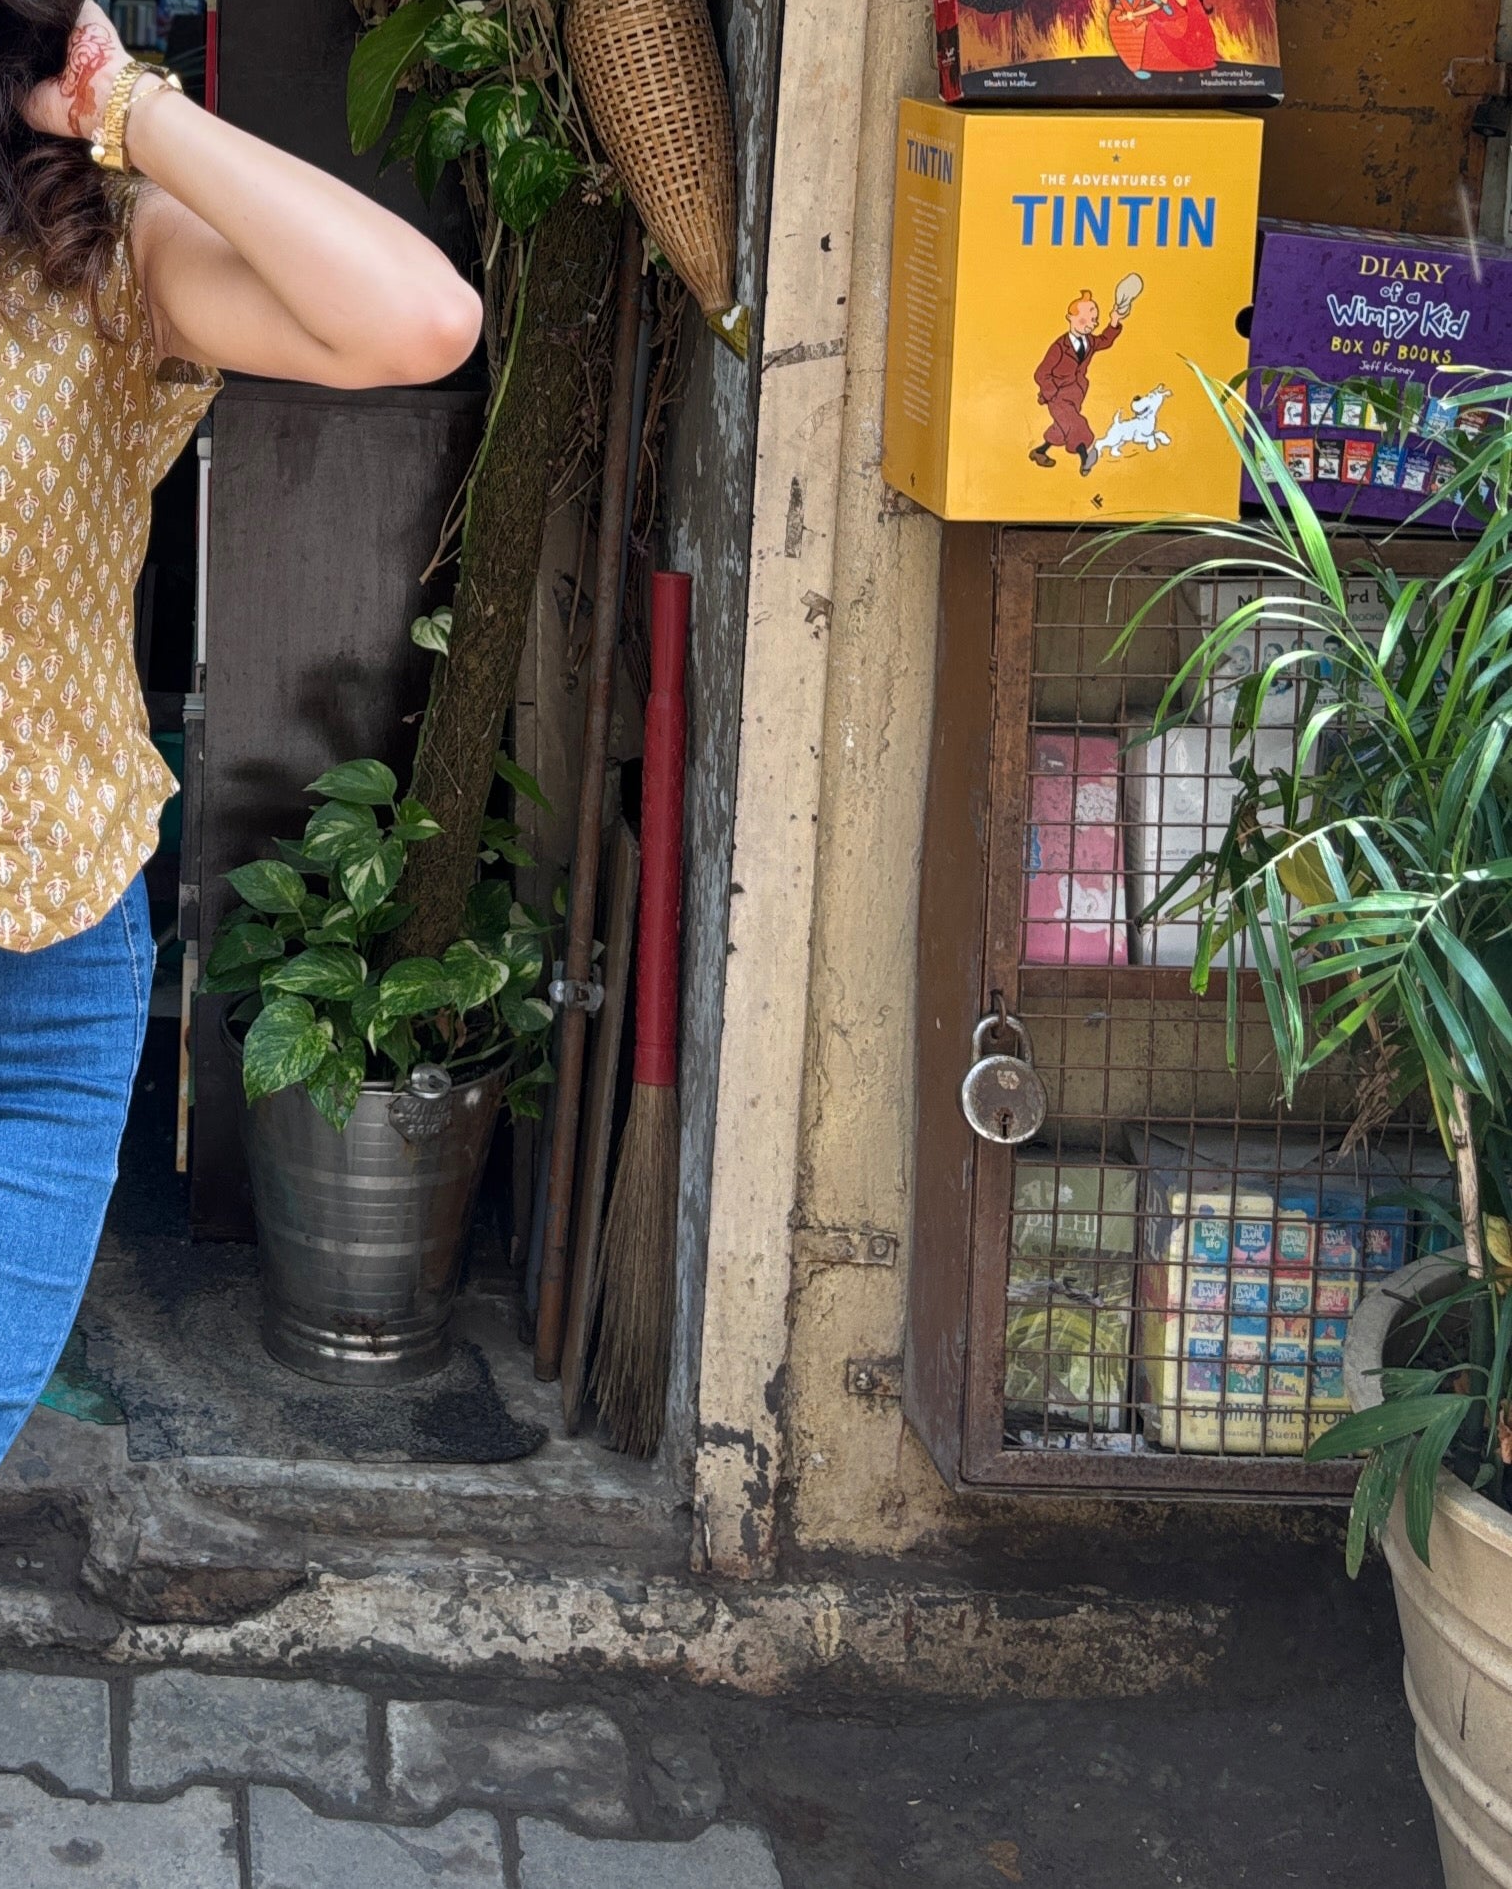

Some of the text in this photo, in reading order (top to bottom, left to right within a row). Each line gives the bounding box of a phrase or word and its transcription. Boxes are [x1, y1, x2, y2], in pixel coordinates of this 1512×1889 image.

[1019, 70, 1029, 81] by
[1098, 137, 1137, 150] HERGÉ
[906, 139, 953, 185] TINTIN
[1039, 173, 1193, 188] THE ADVENTURES OF
[1011, 195, 1217, 248] TINTIN
[1358, 254, 1453, 285] DIARY
[1380, 281, 1421, 305] of a
[1327, 294, 1470, 340] Wimpy Kid
[1331, 336, 1452, 364] BOX OF BOOKS
[1358, 360, 1416, 382] Jeff Kinney
